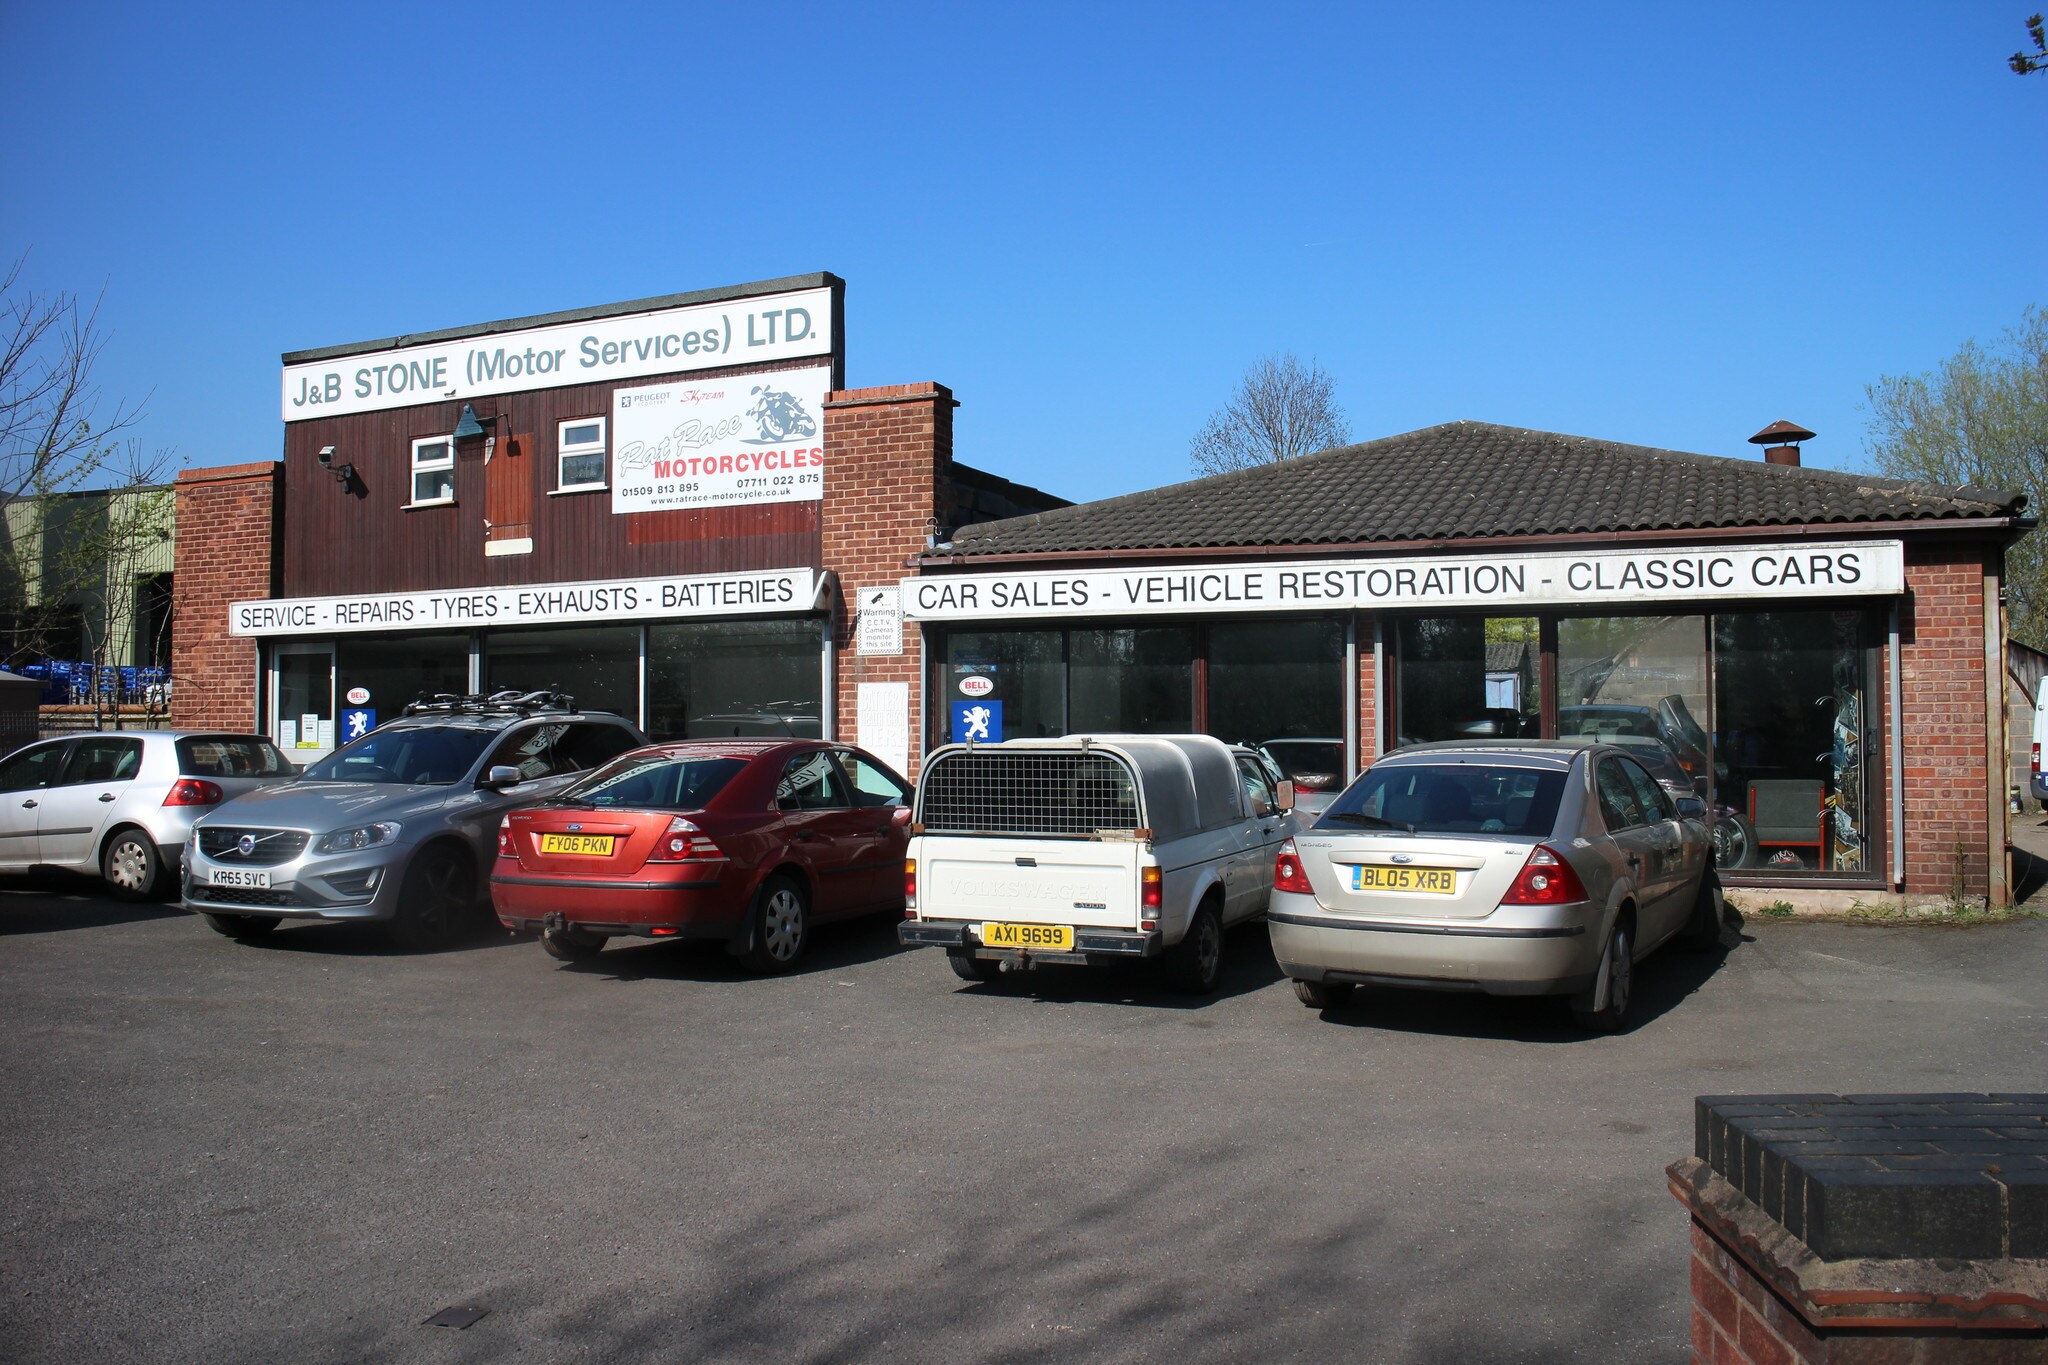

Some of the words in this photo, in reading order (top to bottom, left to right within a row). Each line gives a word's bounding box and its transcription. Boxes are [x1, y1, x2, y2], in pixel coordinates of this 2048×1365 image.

[293, 373, 341, 407] J&B
[354, 357, 447, 399] STONE
[466, 347, 565, 386] (Motor
[579, 314, 731, 368] Services)
[748, 307, 816, 347] LTD.
[634, 392, 670, 402] PEUGEOT
[617, 437, 670, 477] Rat
[673, 415, 743, 456] Race
[654, 447, 823, 479] MOTORCYCLES
[622, 486, 653, 497] 01509
[657, 484, 674, 494] 813
[679, 482, 699, 492] 895
[737, 478, 767, 488] 07711
[773, 476, 794, 486] 022
[799, 474, 819, 484] 875
[651, 488, 791, 505] www.ratrace-motorcycle.co.uk
[918, 583, 978, 609] CAR
[991, 579, 1089, 608] SALES
[1124, 573, 1263, 603] VEHICLE
[1279, 564, 1525, 599] RESTORATION
[1567, 558, 1734, 591] CLASSIC
[1751, 553, 1861, 586] CARS
[240, 605, 316, 628] SERVICE
[335, 600, 414, 624] REPAIRS
[430, 595, 498, 619] TYRES
[518, 587, 638, 615] EXHAUSTS
[662, 578, 794, 608] BATTERIES
[863, 609, 895, 617] Warning
[965, 681, 988, 689] BELL
[547, 836, 578, 851] FY06
[582, 838, 608, 852] PKN
[213, 869, 242, 885] KR65
[244, 872, 266, 887] SVC
[1364, 869, 1410, 887] BL05
[1416, 871, 1451, 890] XRB
[950, 879, 1107, 902] VOLKSWAGEN
[1021, 927, 1063, 944] 9699
